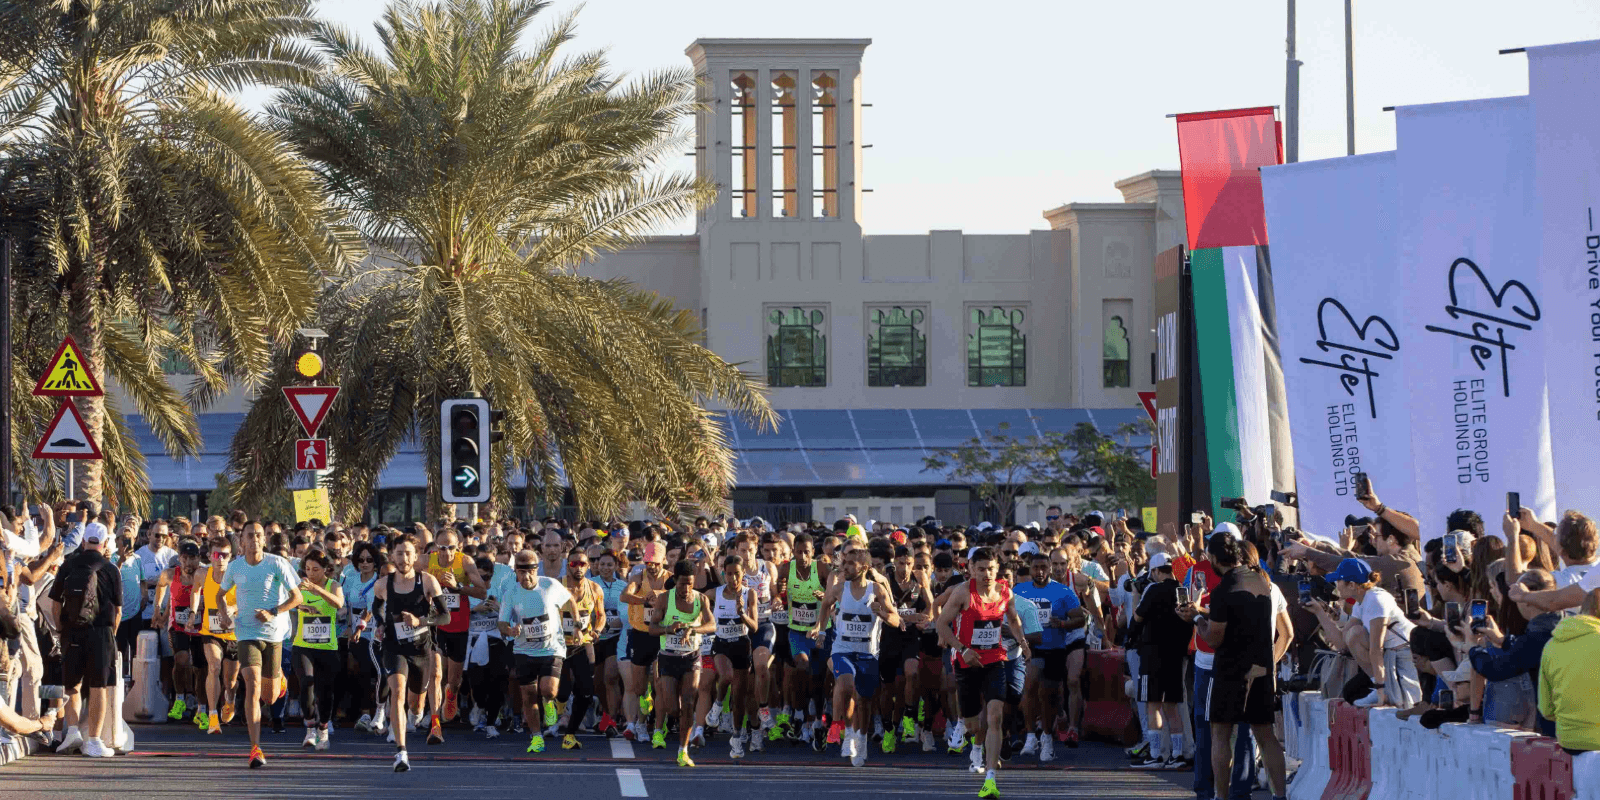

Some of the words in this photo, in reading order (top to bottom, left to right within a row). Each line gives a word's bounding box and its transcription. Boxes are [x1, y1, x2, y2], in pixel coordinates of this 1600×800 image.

[1157, 316, 1165, 381] 10
[1166, 312, 1177, 379] KM
[1453, 380, 1471, 451] HOLDING
[1470, 378, 1487, 425] ELITE
[1157, 406, 1177, 474] START
[1326, 404, 1346, 467] HOLDING
[1341, 402, 1358, 444] ELITE
[1457, 454, 1472, 485] LTD
[1474, 428, 1490, 484] GROUP
[1334, 469, 1348, 497] LTD
[307, 626, 327, 634] 13010
[567, 618, 586, 626] 135
[795, 609, 815, 618] 13266
[846, 623, 867, 632] 13182
